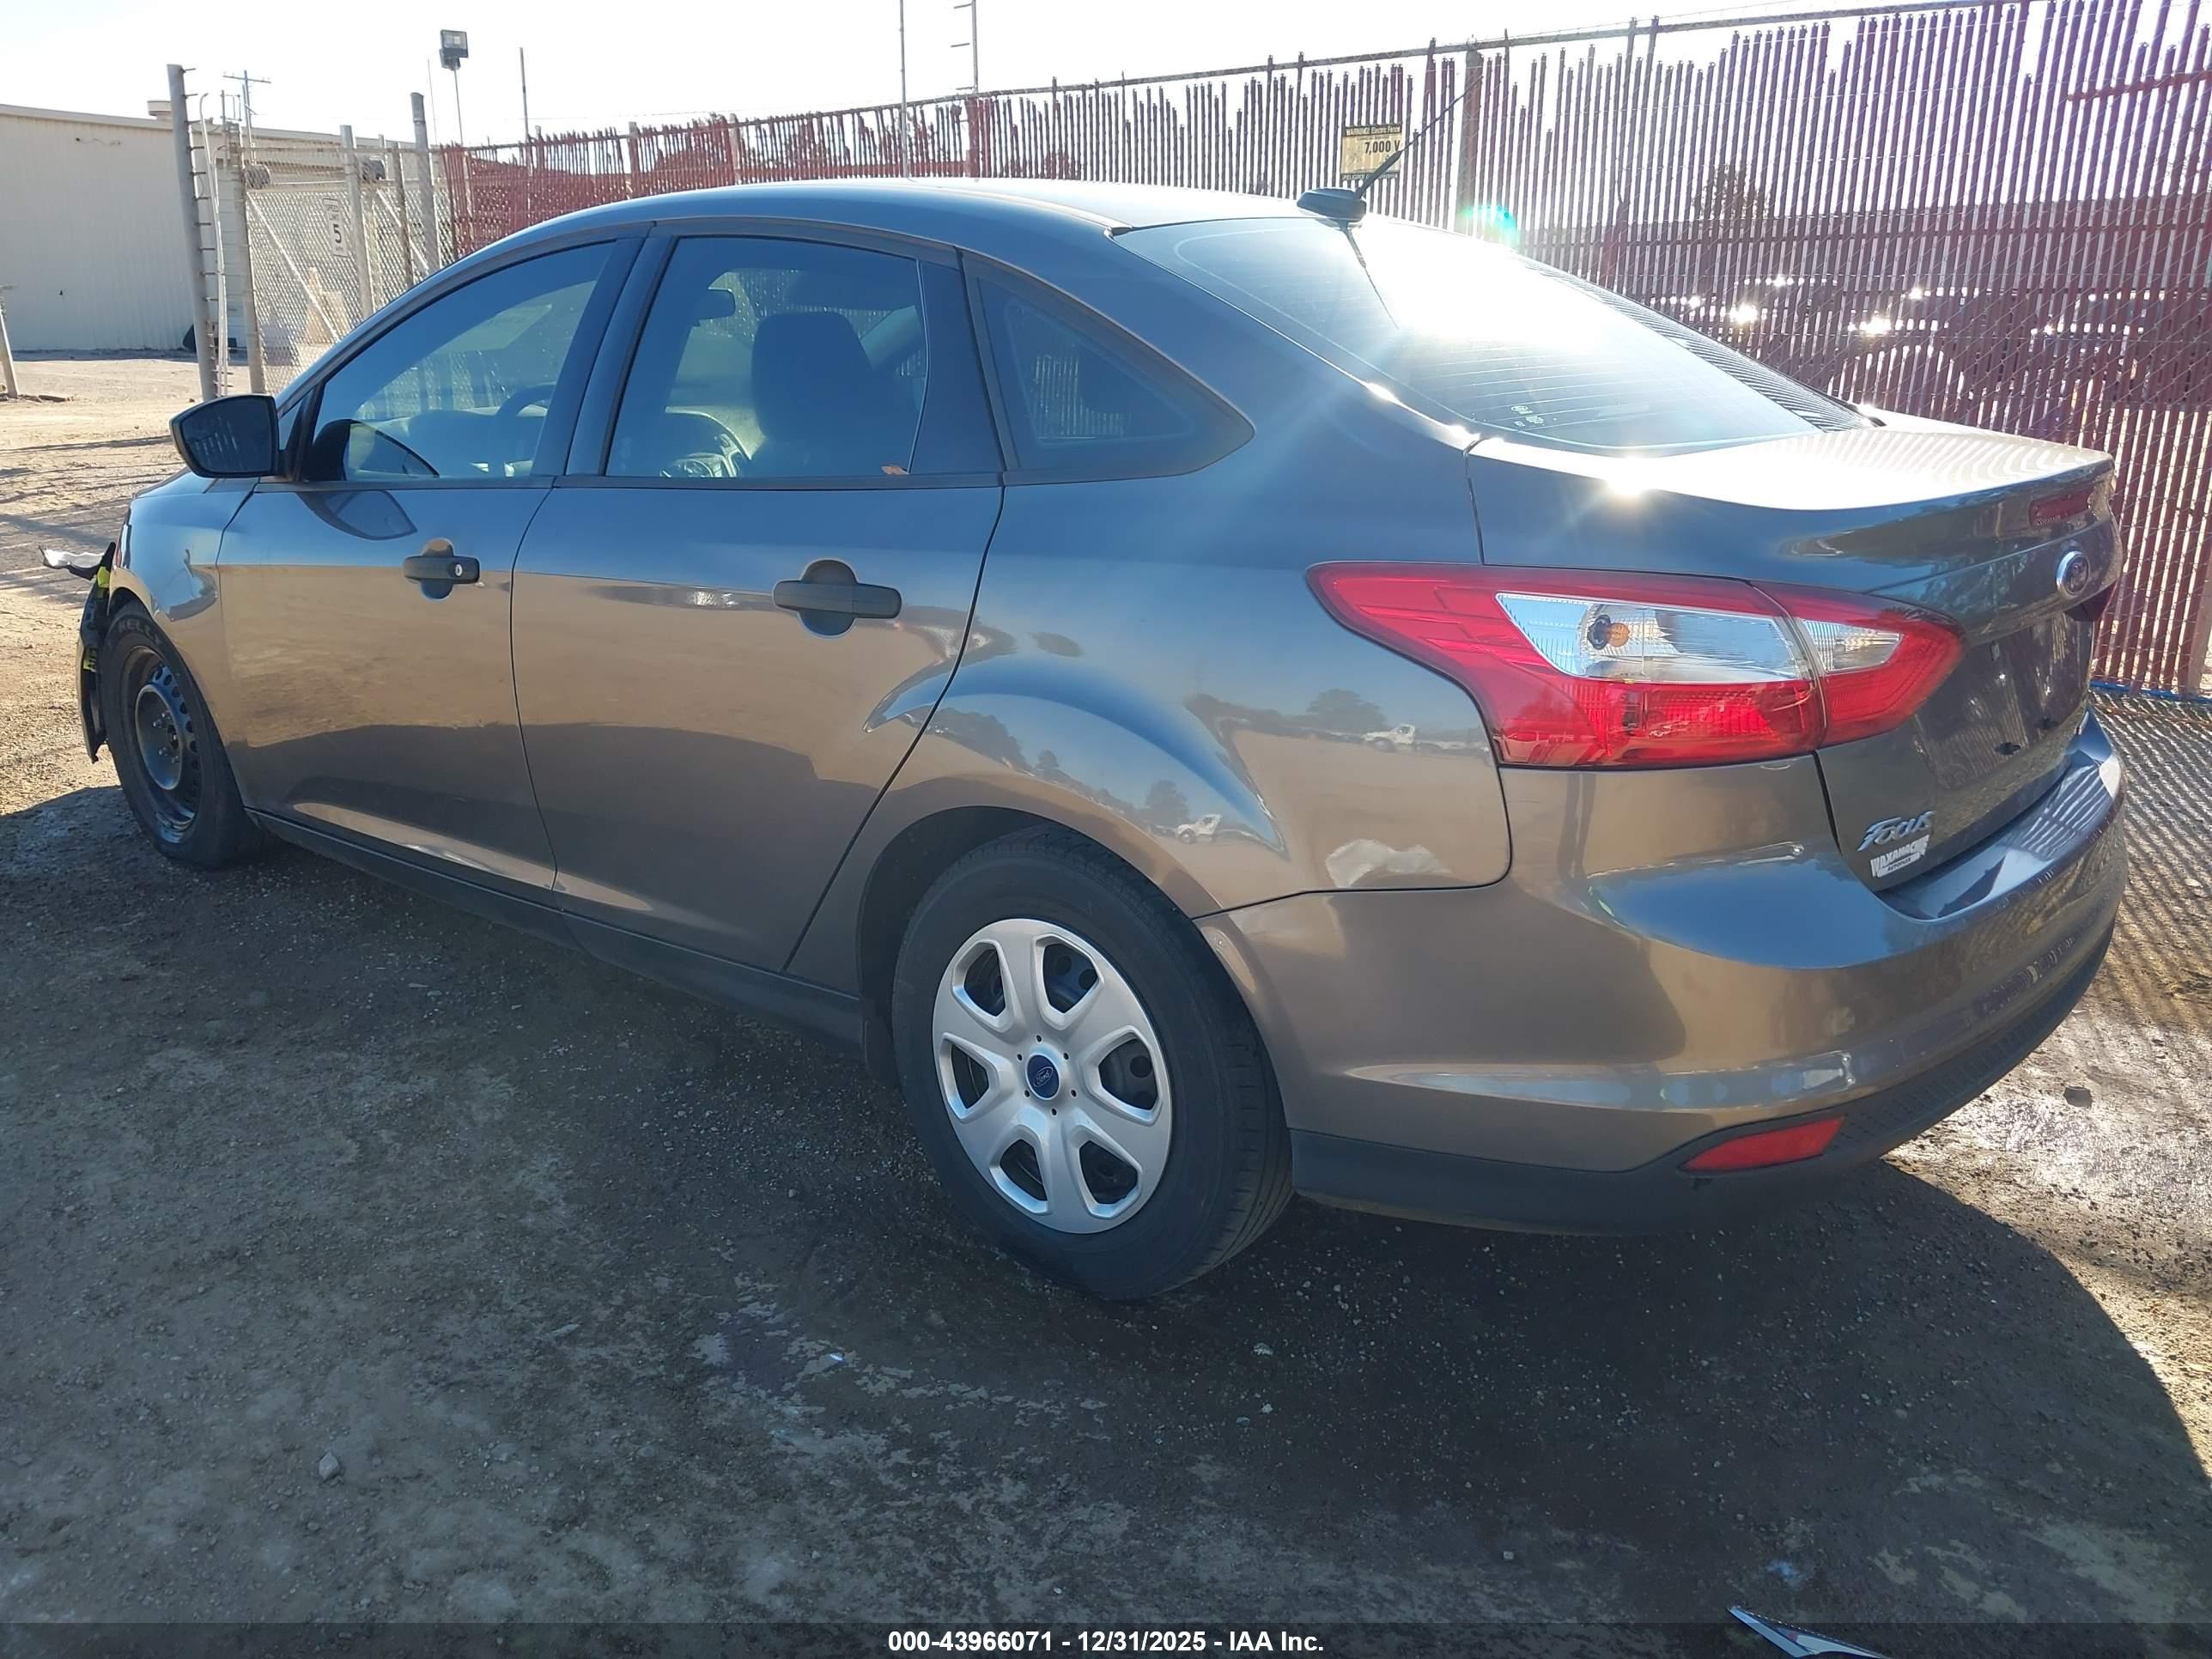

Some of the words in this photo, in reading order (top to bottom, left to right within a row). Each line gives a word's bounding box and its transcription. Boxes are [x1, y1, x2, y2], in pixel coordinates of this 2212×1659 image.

[1364, 140, 1391, 155] 7,000
[1395, 140, 1401, 151] V
[333, 224, 342, 244] 5
[1856, 810, 1937, 852] Focus
